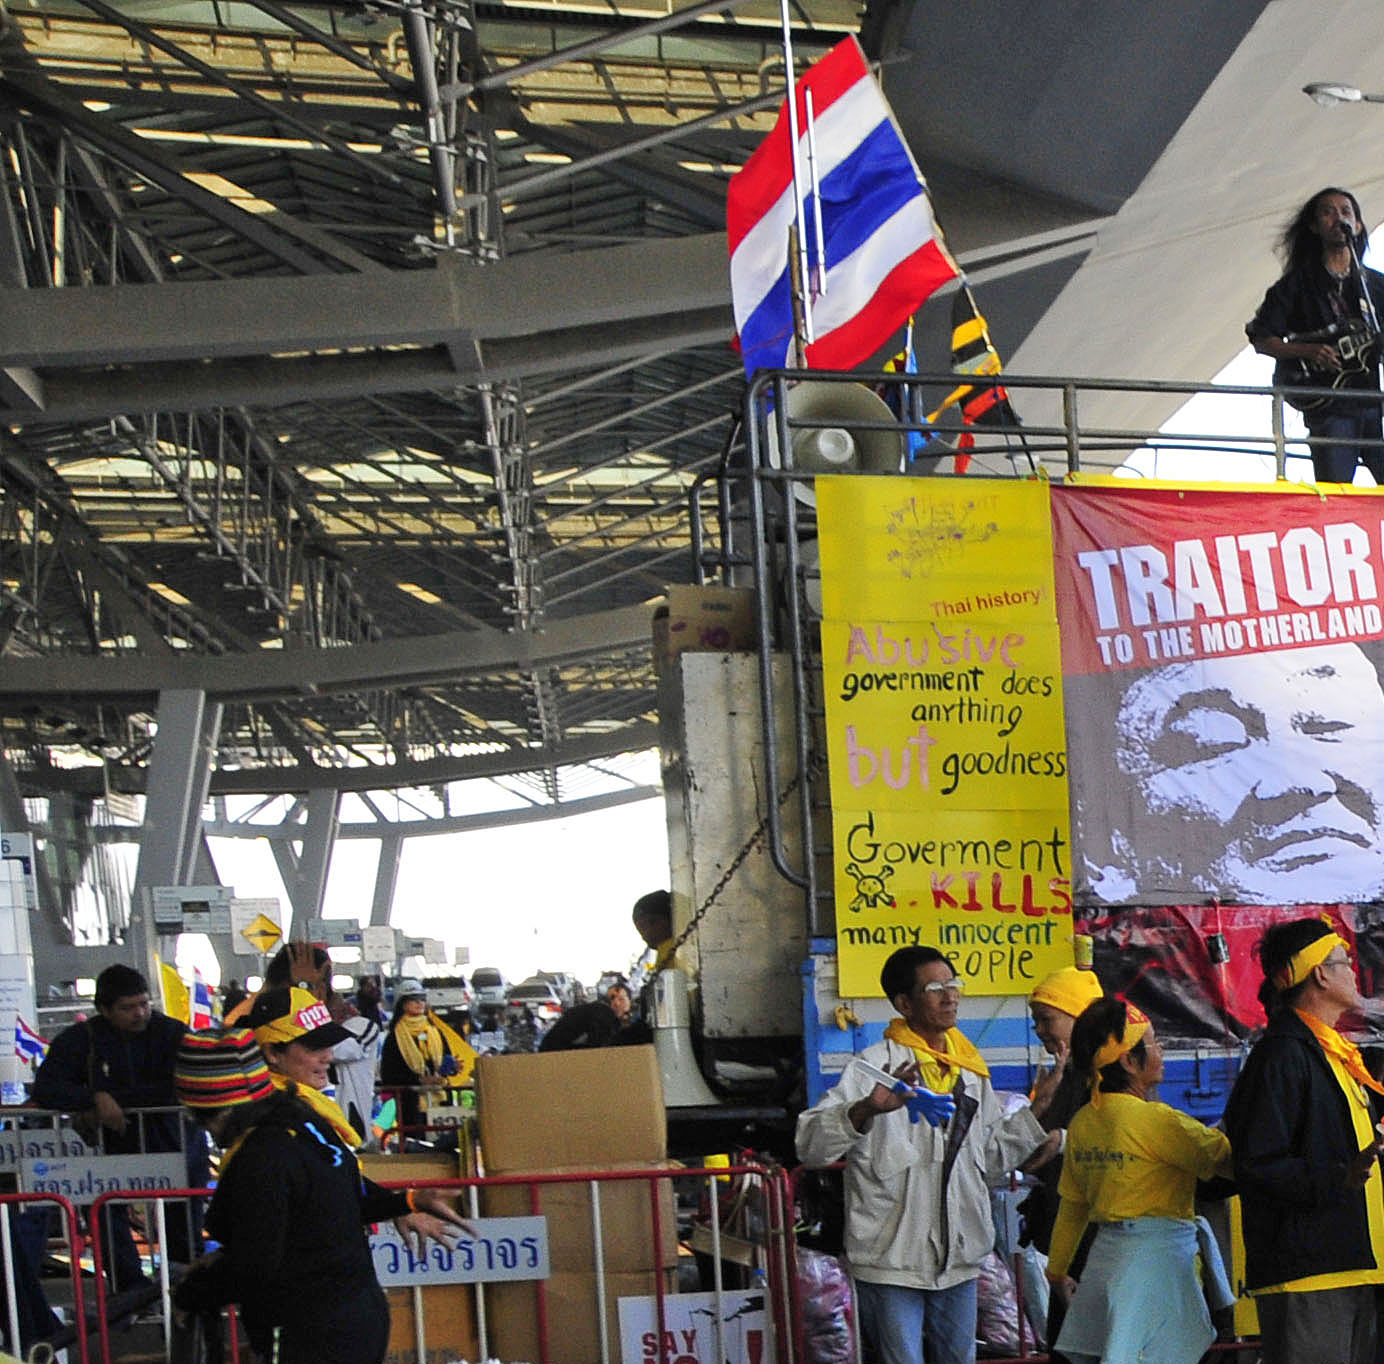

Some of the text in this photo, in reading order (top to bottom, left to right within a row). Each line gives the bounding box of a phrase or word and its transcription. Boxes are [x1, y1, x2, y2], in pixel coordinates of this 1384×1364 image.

[931, 597, 972, 618] Thai
[1097, 604, 1383, 665] TO THE MOTHERLAND
[841, 666, 1053, 701] government does
[912, 697, 1023, 737] anything
[845, 724, 1066, 795] but goodness
[847, 810, 1066, 875] Goverment
[931, 871, 1072, 917] KILLS
[842, 919, 1057, 946] many innocent
[945, 946, 1035, 983] eople
[371, 1235, 540, 1273] วนจราจร
[642, 1329, 697, 1356] SAY
